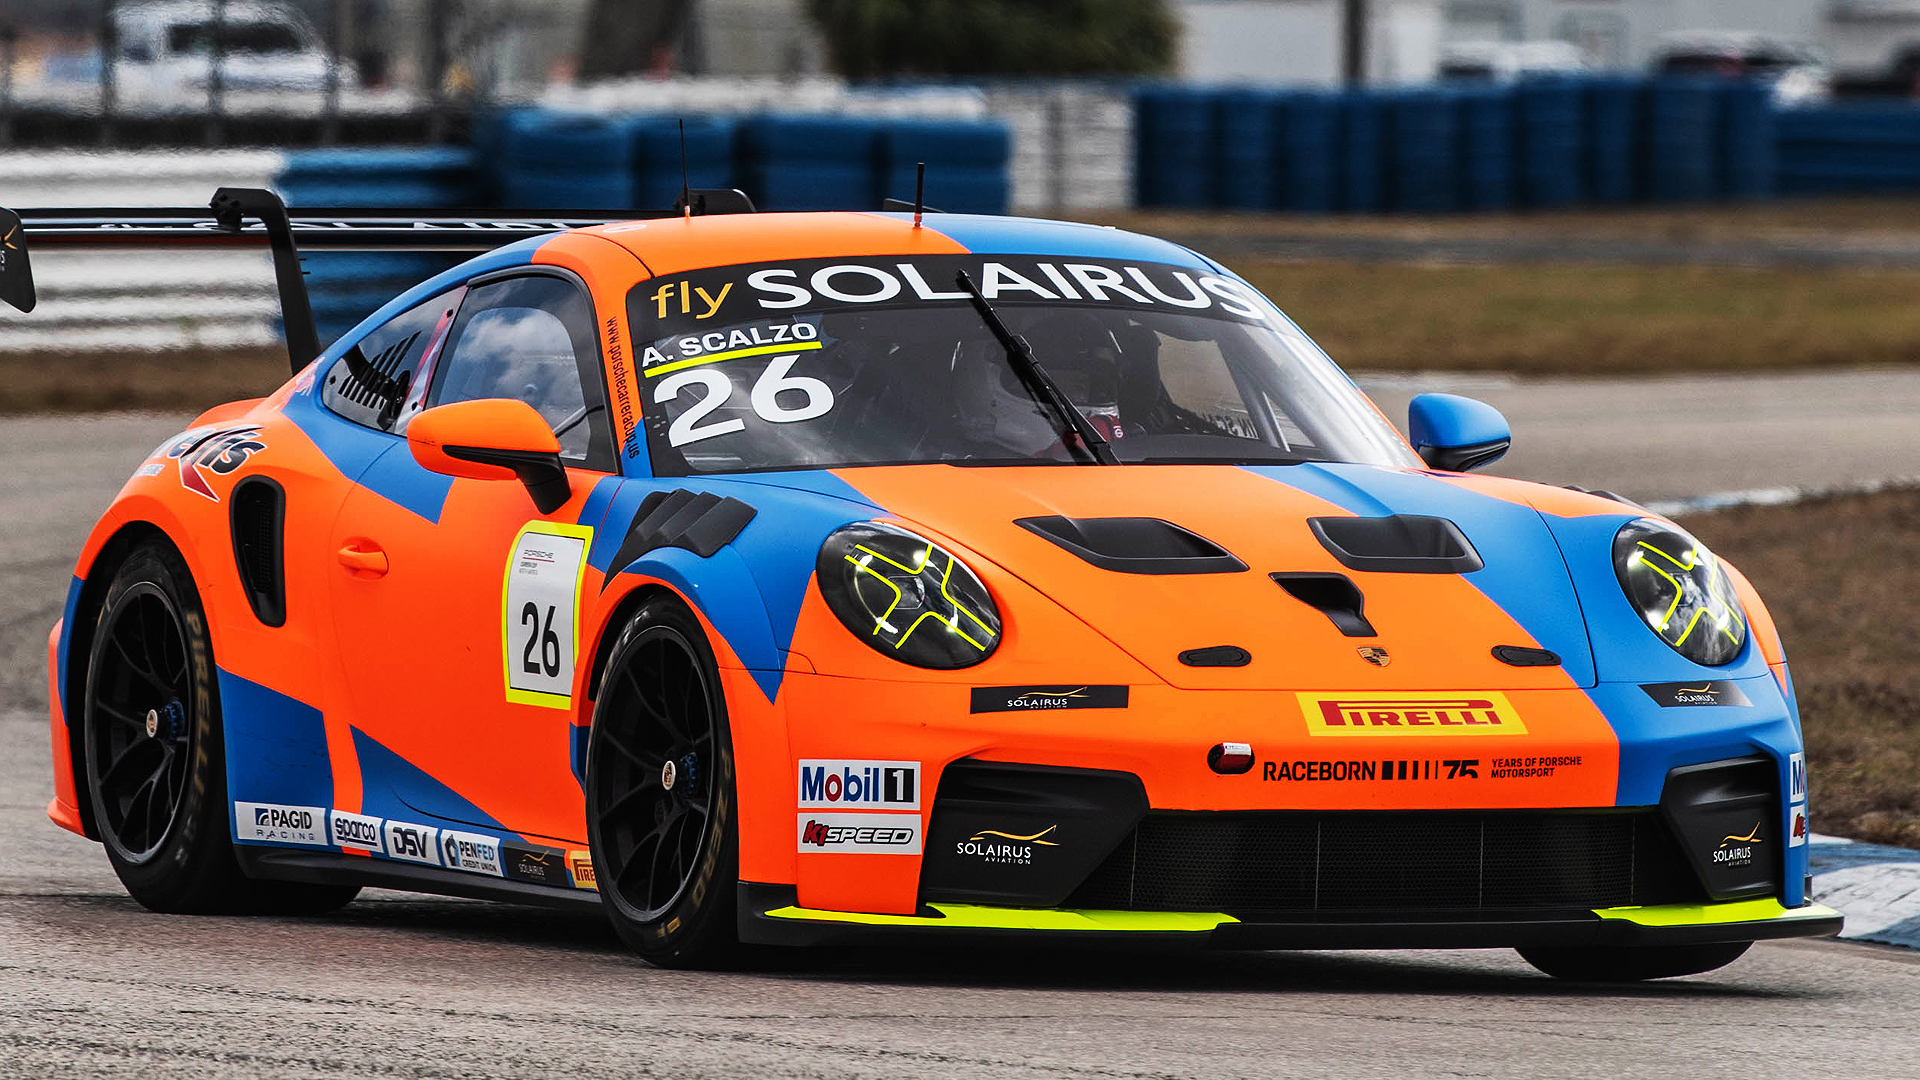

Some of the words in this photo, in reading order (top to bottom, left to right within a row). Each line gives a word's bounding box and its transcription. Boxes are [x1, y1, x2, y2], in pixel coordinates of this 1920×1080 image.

[651, 281, 733, 319] fly
[747, 263, 1266, 319] SOLAIRUS
[641, 347, 673, 368] A.
[679, 322, 817, 356] SCALZO
[653, 354, 834, 448] 26
[521, 602, 560, 678] 26
[1007, 698, 1068, 707] SOLAIRUS
[1317, 699, 1502, 726] PIRELLI
[1263, 761, 1376, 781] RACEBORN
[1443, 759, 1479, 779] 75
[1491, 767, 1555, 778] MOTORSPORT
[1492, 758, 1522, 768] YEARS
[1525, 757, 1537, 767] OF
[1539, 756, 1582, 767] PORSCHE
[802, 766, 879, 802] Mobil
[271, 808, 312, 830] PAGID
[257, 829, 315, 842] RACING
[335, 817, 376, 844] sparco
[393, 826, 427, 858] DSV
[459, 840, 494, 861] PENFED
[957, 842, 1032, 859] SOLAIRUS
[985, 856, 1031, 865] AVIATION
[1713, 847, 1751, 863] SOLAIRUS
